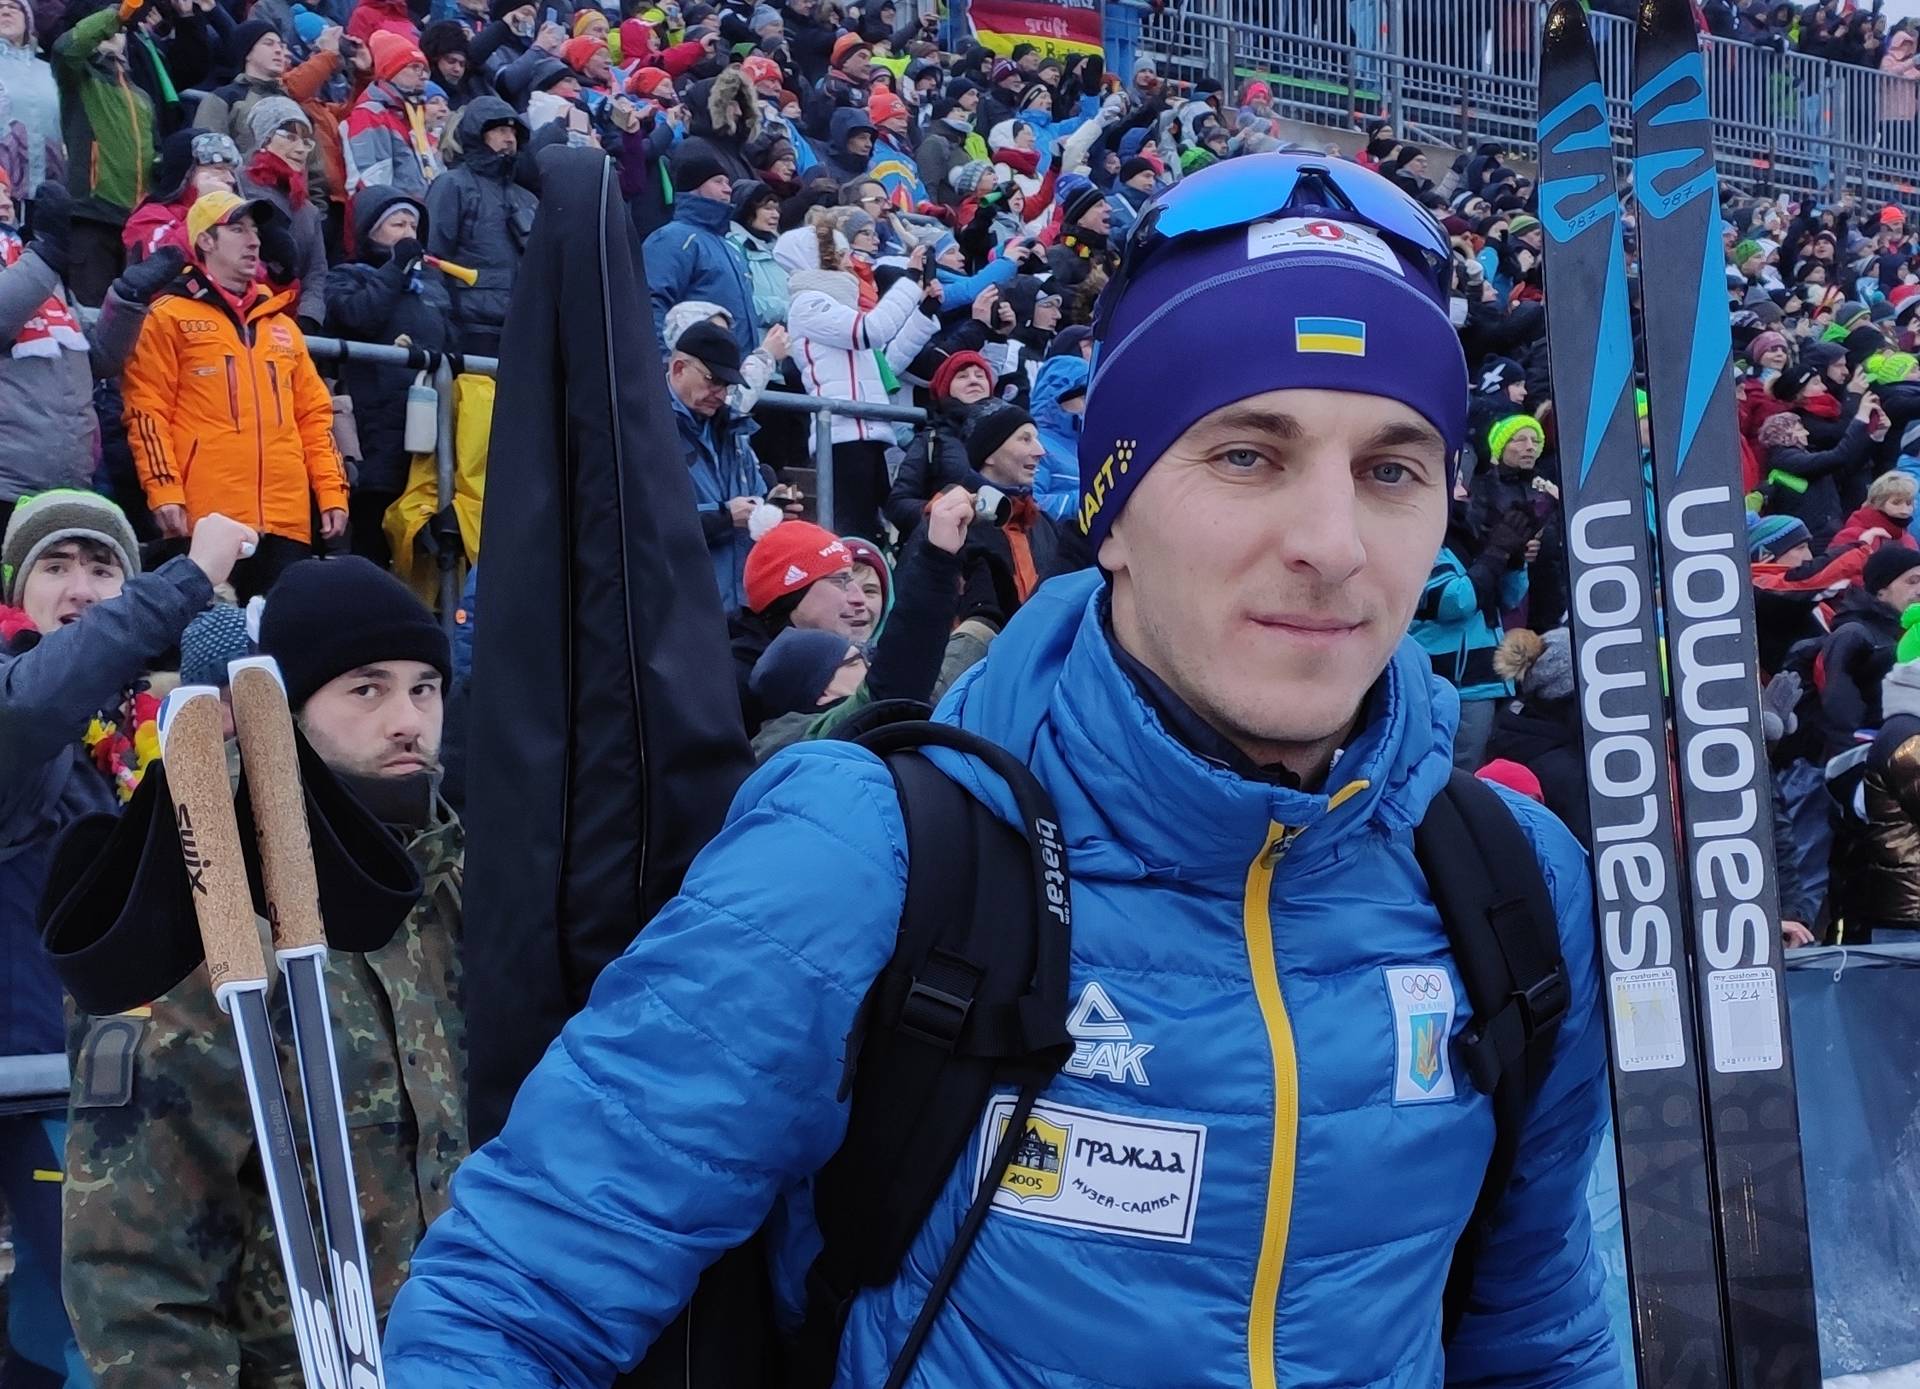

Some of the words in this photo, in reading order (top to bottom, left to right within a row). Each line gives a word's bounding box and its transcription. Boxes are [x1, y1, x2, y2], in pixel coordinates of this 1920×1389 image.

[1661, 185, 1696, 210] 987
[1567, 210, 1598, 233] 987
[1078, 454, 1114, 536] AFT
[1062, 1041, 1155, 1086] EAK
[1007, 1172, 1043, 1190] 2005
